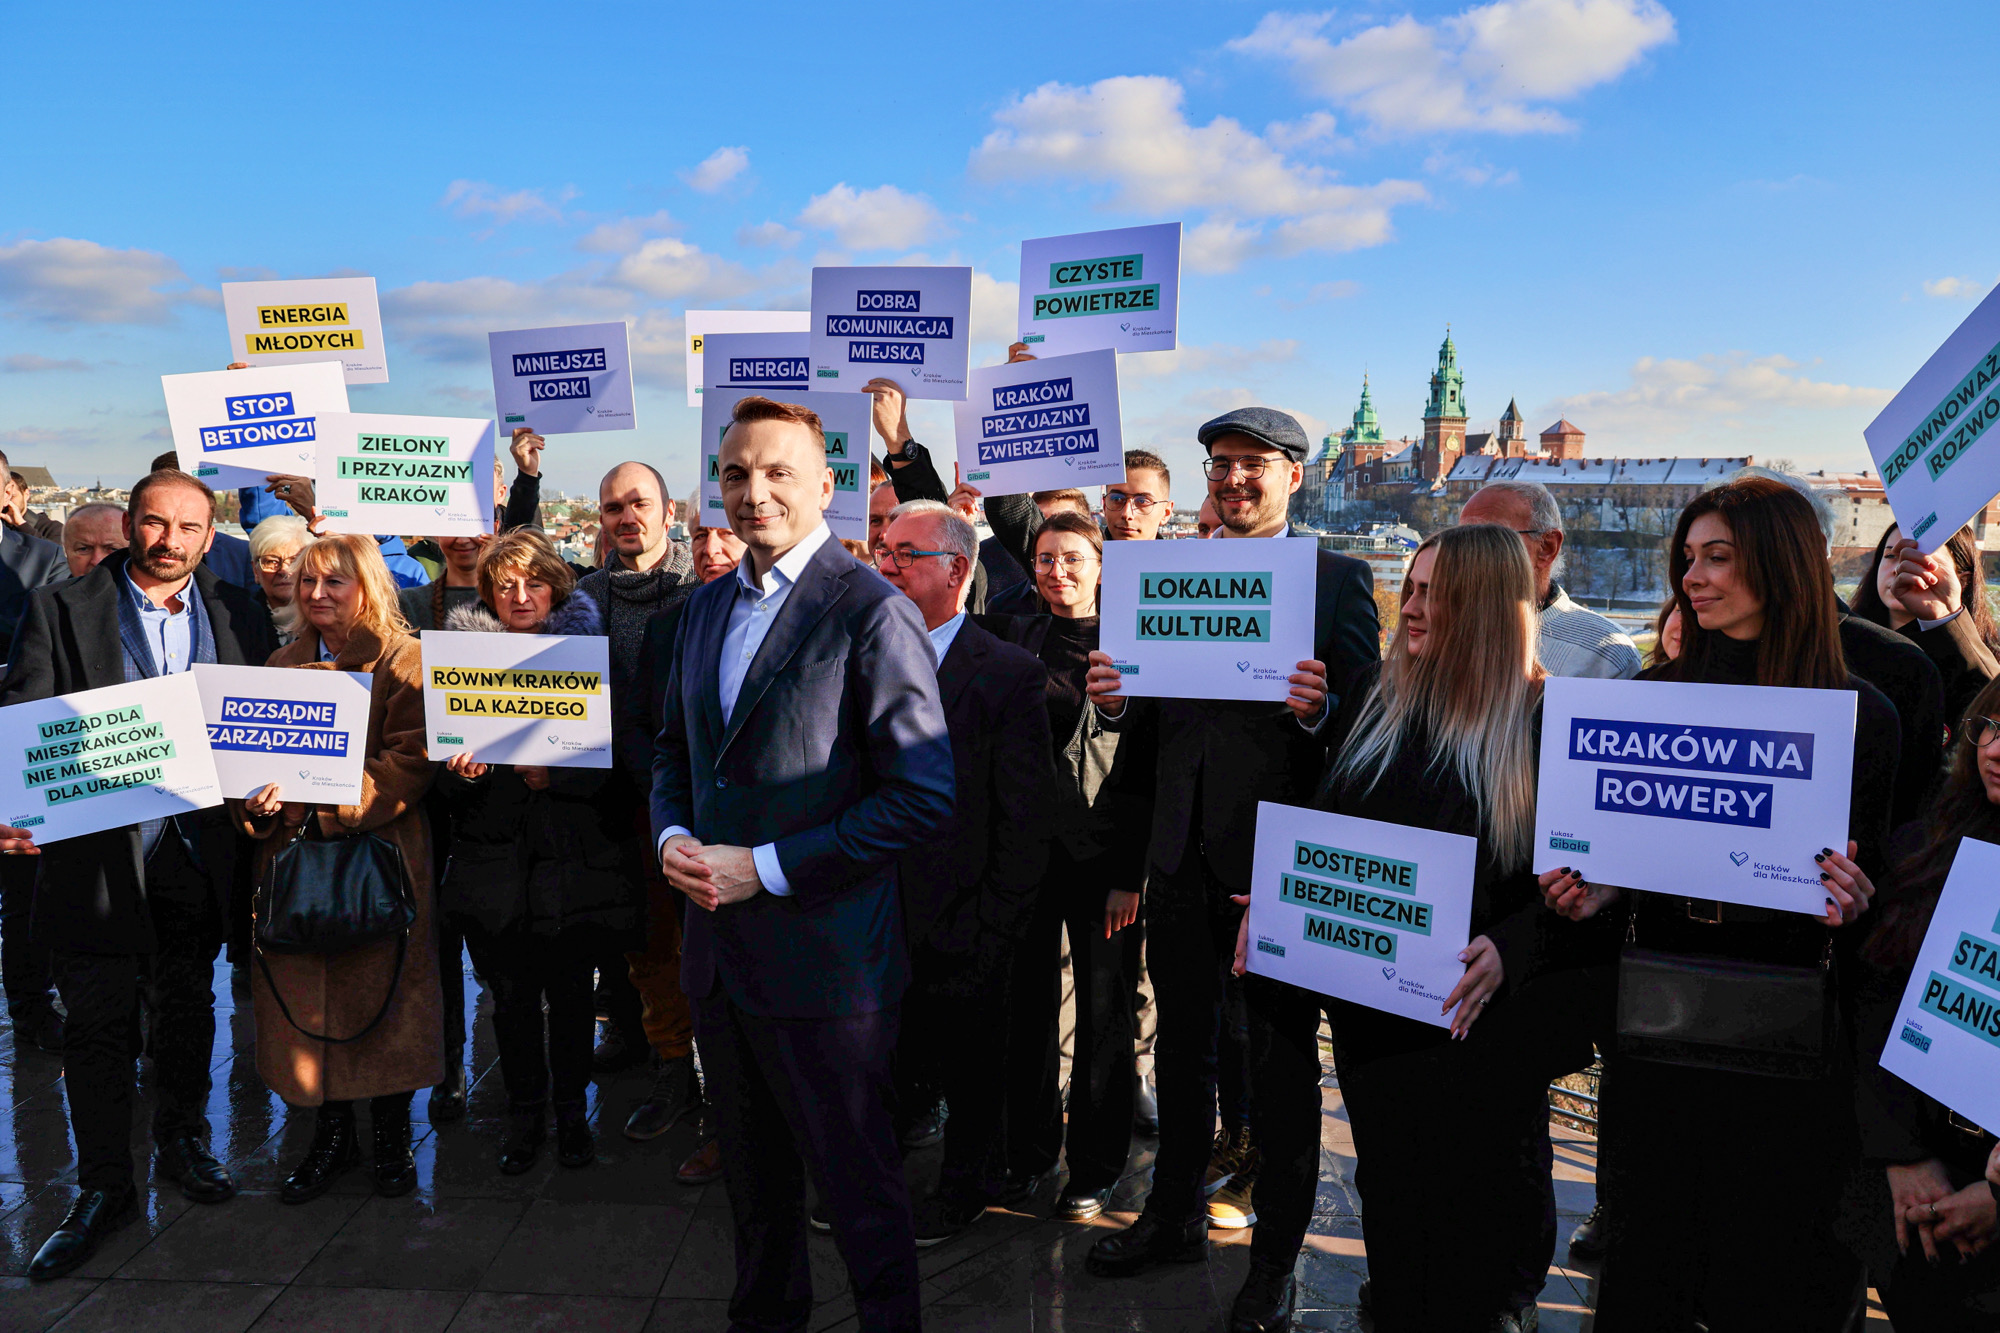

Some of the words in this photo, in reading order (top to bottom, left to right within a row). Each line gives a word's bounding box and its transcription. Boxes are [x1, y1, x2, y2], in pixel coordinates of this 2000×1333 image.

[1056, 260, 1134, 284] CZYSTE
[860, 294, 917, 310] DOBRA
[1035, 288, 1154, 316] POWIETRZE
[261, 306, 346, 324] ENERGIA
[828, 318, 949, 336] KOMUNIKACJA
[255, 332, 354, 352] MŁODYCH
[1022, 336, 1045, 344] Gibała
[516, 352, 604, 373] MNIEJSZE
[851, 344, 922, 360] MIEJSKA
[732, 362, 808, 378] ENERGIA
[533, 380, 588, 398] KORKI
[996, 382, 1070, 407] KRAKÓW
[232, 396, 289, 417] STOP
[984, 407, 1087, 434] PRZYJAZNY
[203, 421, 316, 448] BETONOZI
[1930, 394, 2000, 475] ROZWÓ
[362, 437, 446, 454] ZIELONY
[980, 432, 1096, 460] ZWIERZĘTOM
[342, 462, 347, 475] I
[352, 462, 470, 480] PRZYJAZNY
[967, 472, 990, 481] Gibała
[360, 482, 446, 503] KRAKÓW
[1913, 514, 1937, 538] Gibała
[1144, 578, 1267, 599] LOKALNA
[1140, 616, 1262, 638] KULTURA
[433, 668, 508, 688] RÓWNY
[512, 672, 599, 691] KRAKÓW
[224, 700, 334, 724] ROZSĄDNE
[449, 697, 487, 713] DLA
[492, 696, 585, 716] KAŻDEGO
[41, 716, 103, 739] URZĄD
[106, 708, 141, 726] DLA
[27, 724, 164, 763] MIESZKAŃCÓW,
[207, 727, 346, 752] ZARZĄDZANIE
[1576, 728, 1738, 765] KRAKÓW
[1748, 740, 1804, 772] NA
[27, 766, 56, 785] NIE
[60, 744, 171, 778] MIESZKAŃCY
[48, 783, 84, 802] DLA
[86, 767, 162, 794] URZĘDU!
[1601, 777, 1768, 818] ROWERY
[12, 816, 44, 829] Gibała
[1550, 830, 1574, 838] Łukasz
[1550, 838, 1589, 852] Gibała
[1296, 846, 1412, 887] DOSTĘPNE
[1753, 870, 1768, 878] dla
[1754, 862, 1790, 873] Kraków
[1283, 877, 1289, 896] I
[1294, 880, 1428, 928] BEZPIECZNE
[1258, 934, 1274, 943] Łukasz
[1307, 918, 1393, 955] MIASTO
[1257, 942, 1286, 956] Gibała
[1954, 940, 2000, 982] STA
[1398, 985, 1409, 993] dla
[1410, 988, 1446, 1002] Mieszkańc
[1399, 978, 1424, 990] Kraków
[1906, 1017, 1923, 1032] Łukasz
[1902, 1027, 1930, 1050] Gibała
